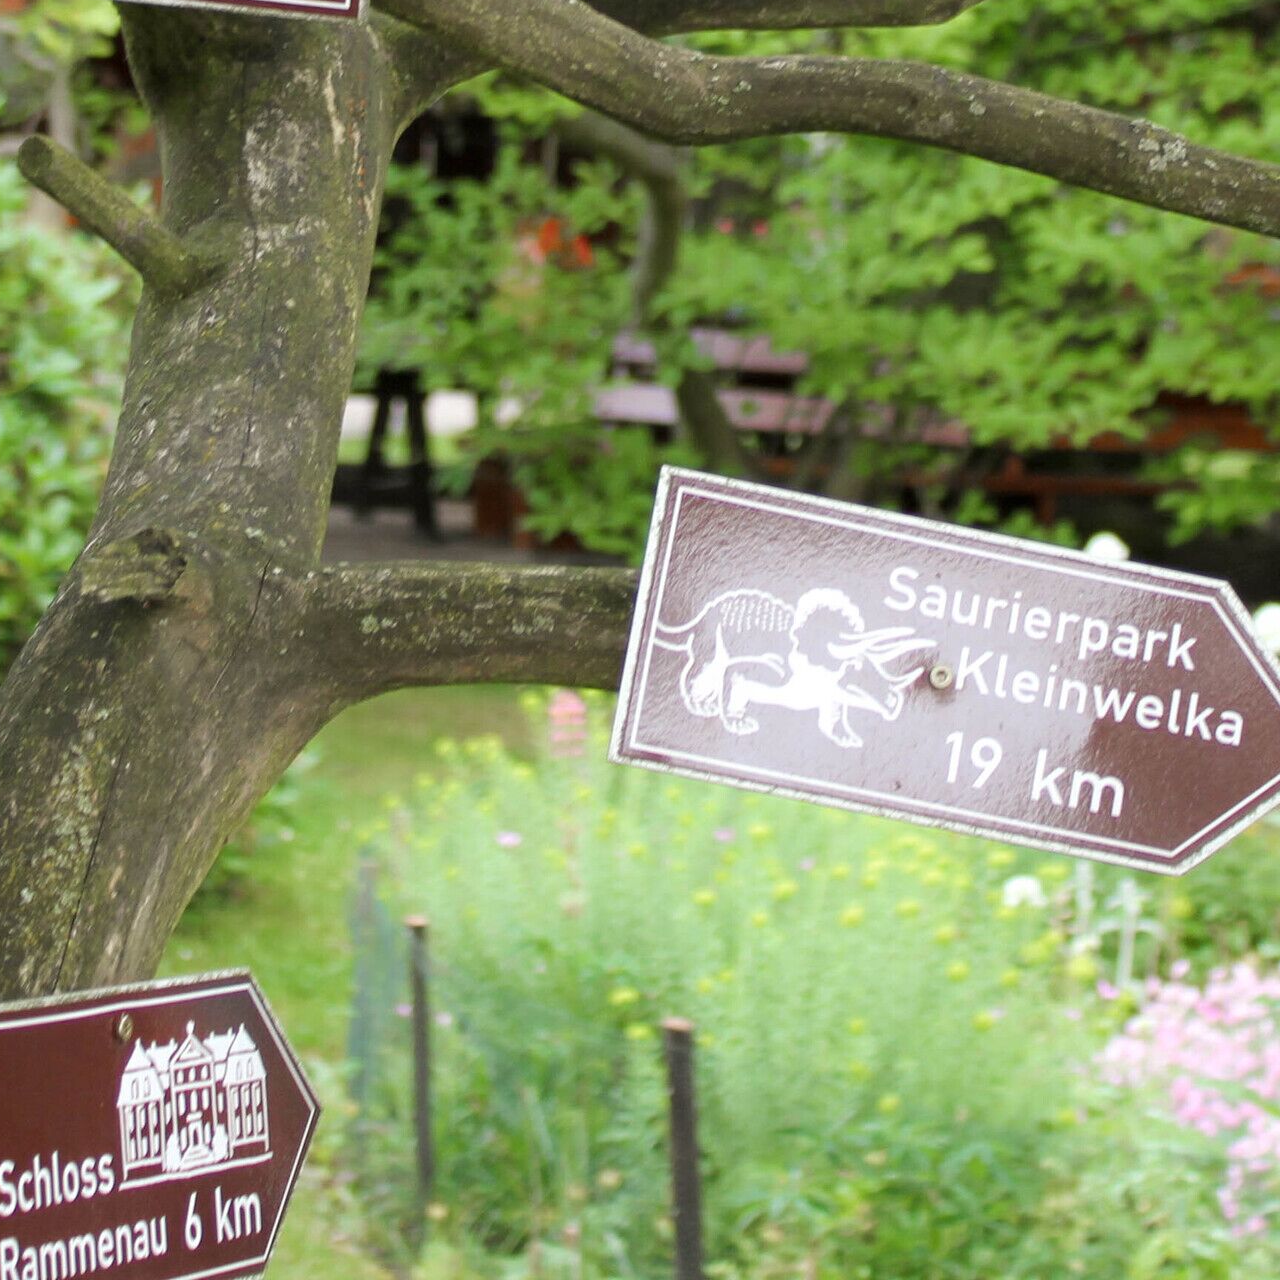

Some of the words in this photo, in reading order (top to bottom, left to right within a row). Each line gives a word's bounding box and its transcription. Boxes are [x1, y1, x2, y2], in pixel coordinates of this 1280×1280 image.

[883, 565, 1197, 672] Saurierpark
[954, 648, 1245, 748] Kleinwelka
[945, 730, 1003, 789] 19
[1030, 747, 1126, 818] km
[184, 1191, 202, 1250] 6
[214, 1186, 262, 1243] km
